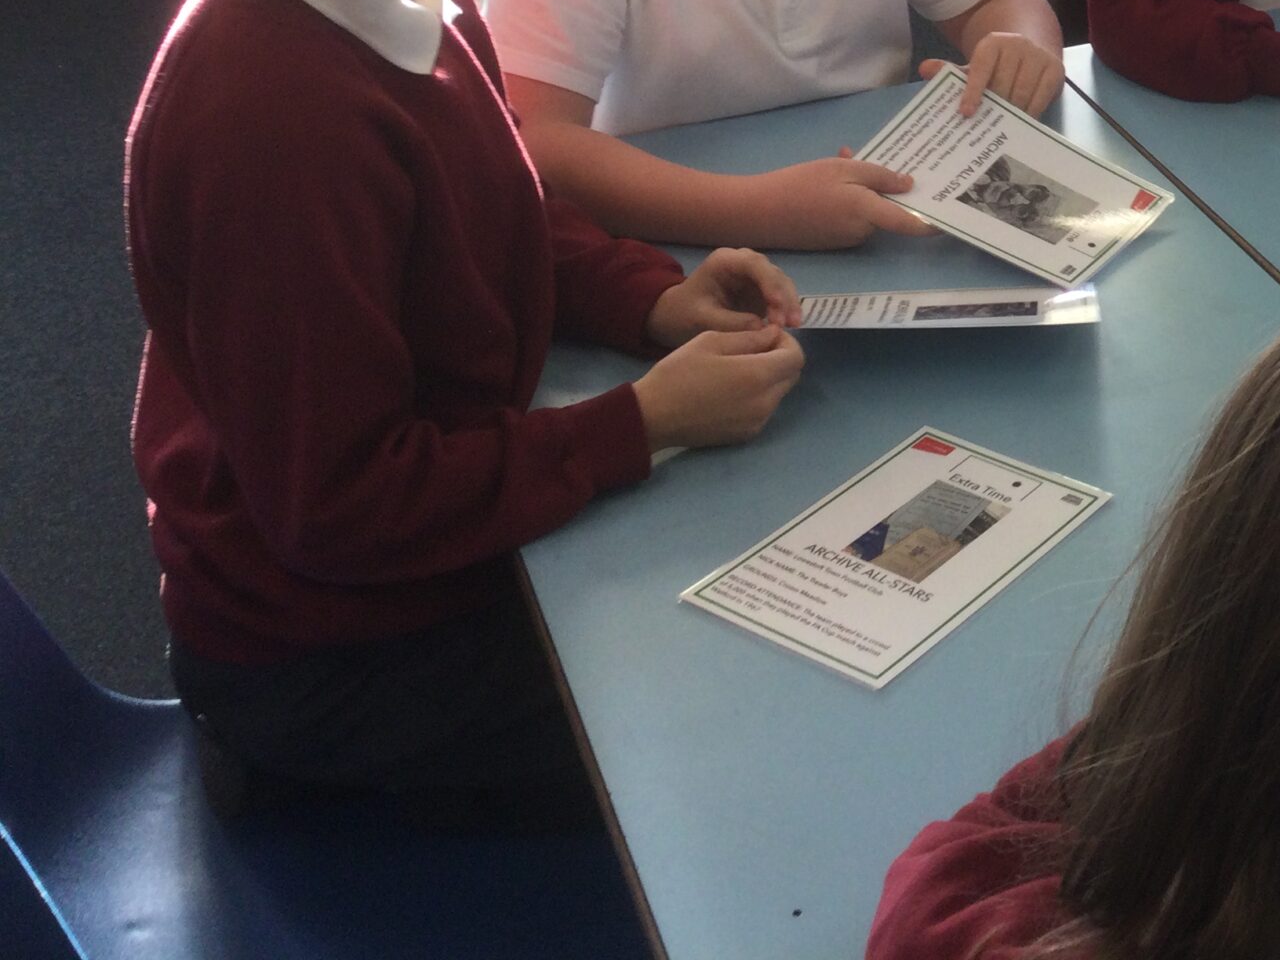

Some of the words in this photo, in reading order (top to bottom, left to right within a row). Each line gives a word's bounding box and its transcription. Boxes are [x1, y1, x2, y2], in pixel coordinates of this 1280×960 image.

[971, 132, 1009, 166] ARCHIVE
[932, 165, 975, 202] ALL-STARS
[949, 474, 983, 489] Extra
[980, 487, 1016, 502] Time
[804, 543, 865, 571] ARCHIVE
[862, 568, 936, 601] ALL-STARS
